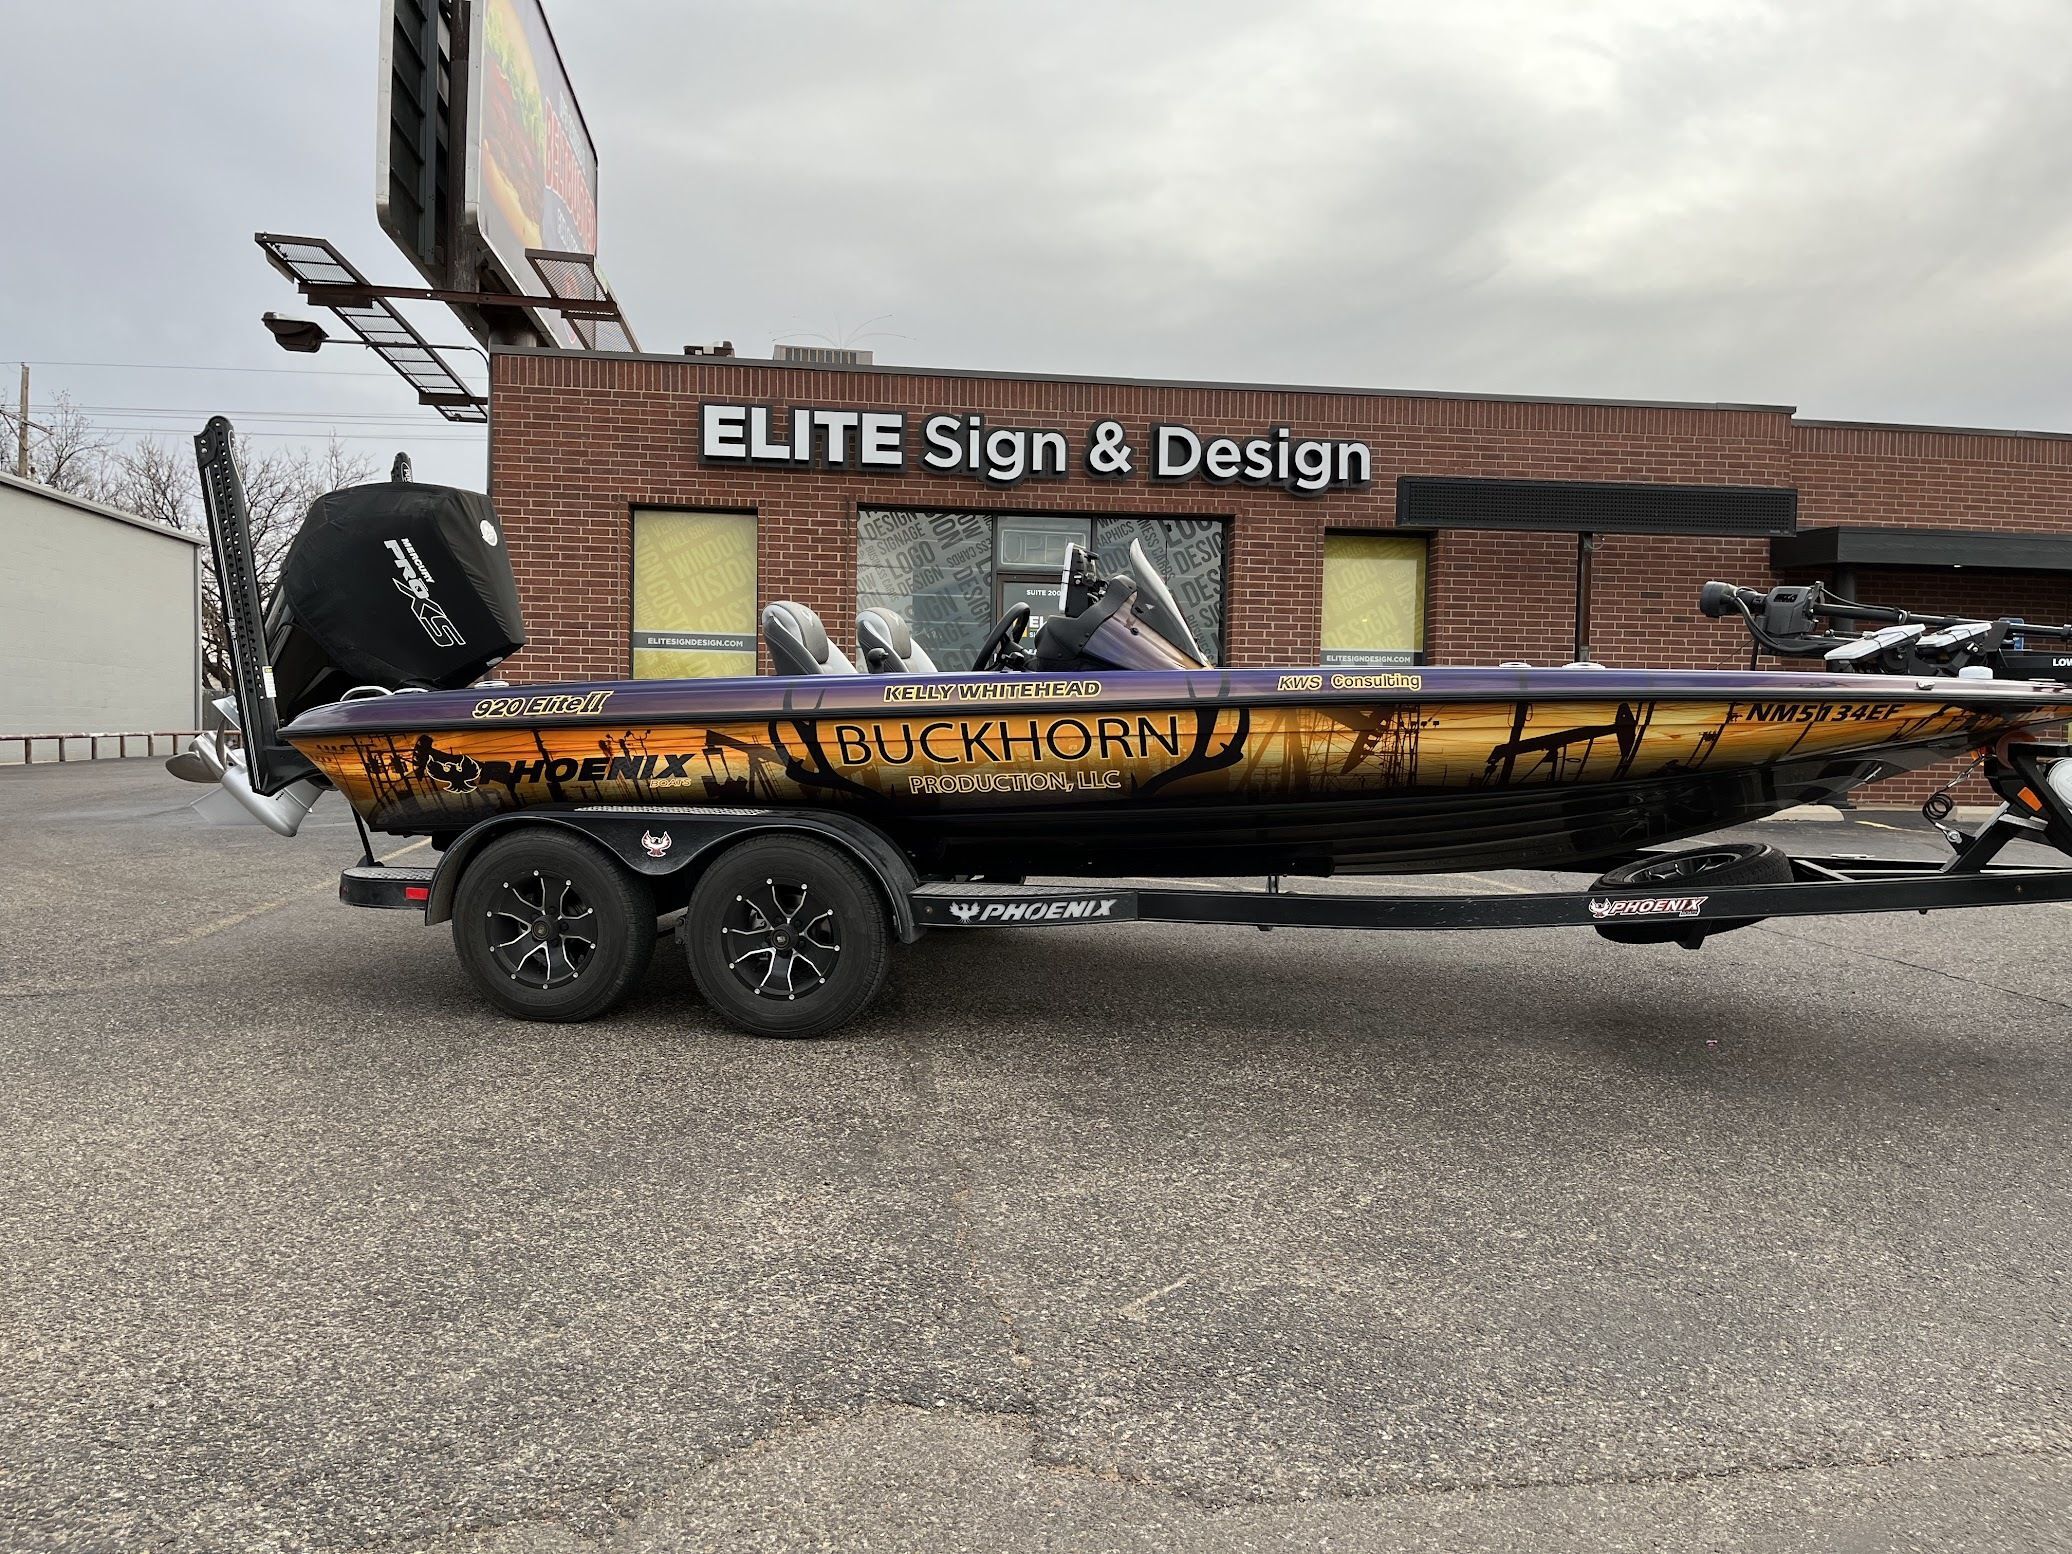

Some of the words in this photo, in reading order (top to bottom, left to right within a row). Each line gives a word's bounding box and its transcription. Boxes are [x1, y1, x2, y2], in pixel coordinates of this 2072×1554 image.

[703, 404, 903, 465] ELITE
[924, 415, 1067, 481] Sign
[1089, 421, 1132, 473] &
[1158, 426, 1371, 490] Design
[667, 526, 751, 580] WINDOW
[877, 522, 926, 556] SIGNAGE
[383, 539, 430, 600] PRO
[400, 538, 436, 584] MERCURY
[885, 540, 936, 581] LOGO
[897, 564, 945, 597] DESIGN
[1026, 589, 1047, 597] SUITE
[1342, 581, 1386, 612] DESIGN
[391, 577, 467, 648] XS
[647, 637, 744, 648] ELITESIGNDESIGN.COM
[1326, 654, 1411, 664] ELITESIGNDESIGN.COM
[883, 684, 956, 703] KELLY
[957, 680, 1102, 700] WHITEHEAD
[1277, 674, 1323, 690] KWS
[1330, 673, 1422, 691] Consulting
[472, 699, 527, 719] 920
[834, 714, 1183, 767] BUCKHORN
[478, 753, 696, 785] PHOENIX
[908, 772, 1074, 794] PRODUCTION,
[1076, 770, 1122, 789] LLC
[978, 899, 1118, 921] PHOENIX
[1609, 896, 1707, 915] PHOENIX
